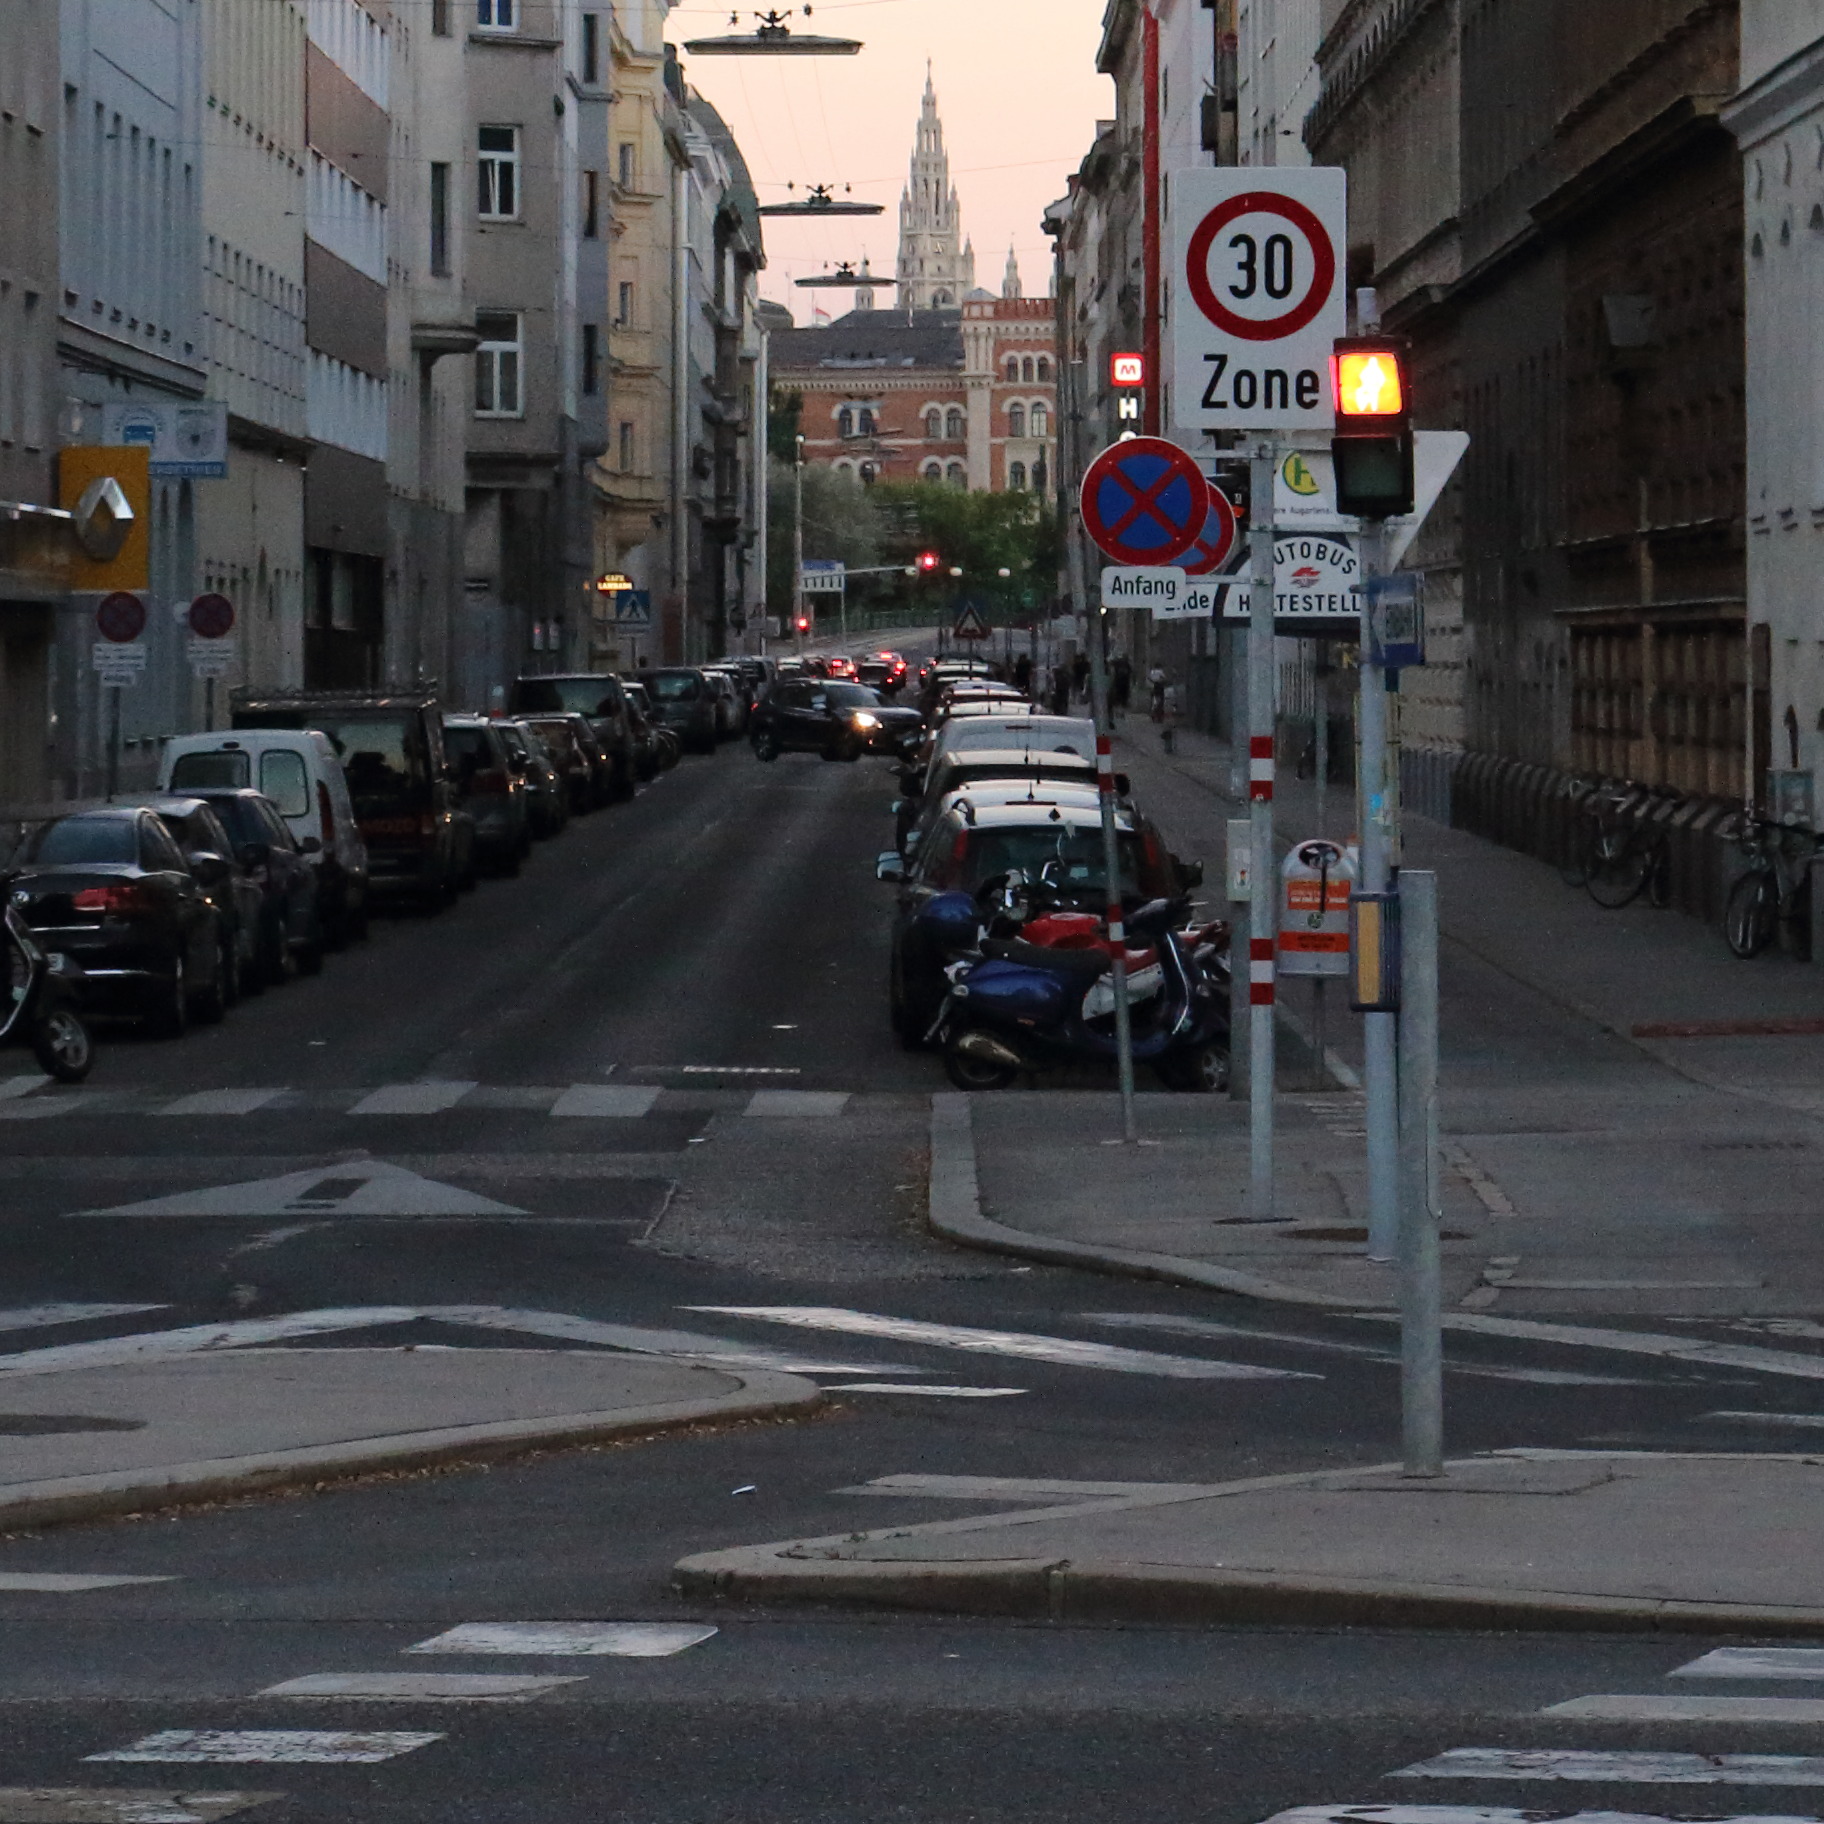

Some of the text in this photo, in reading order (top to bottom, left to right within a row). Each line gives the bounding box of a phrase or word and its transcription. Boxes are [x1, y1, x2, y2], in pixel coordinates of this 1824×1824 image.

[1227, 232, 1294, 300] 30
[1200, 353, 1320, 410] Zone
[1274, 541, 1357, 575] UTOBUS
[1110, 575, 1177, 600] Anfang
